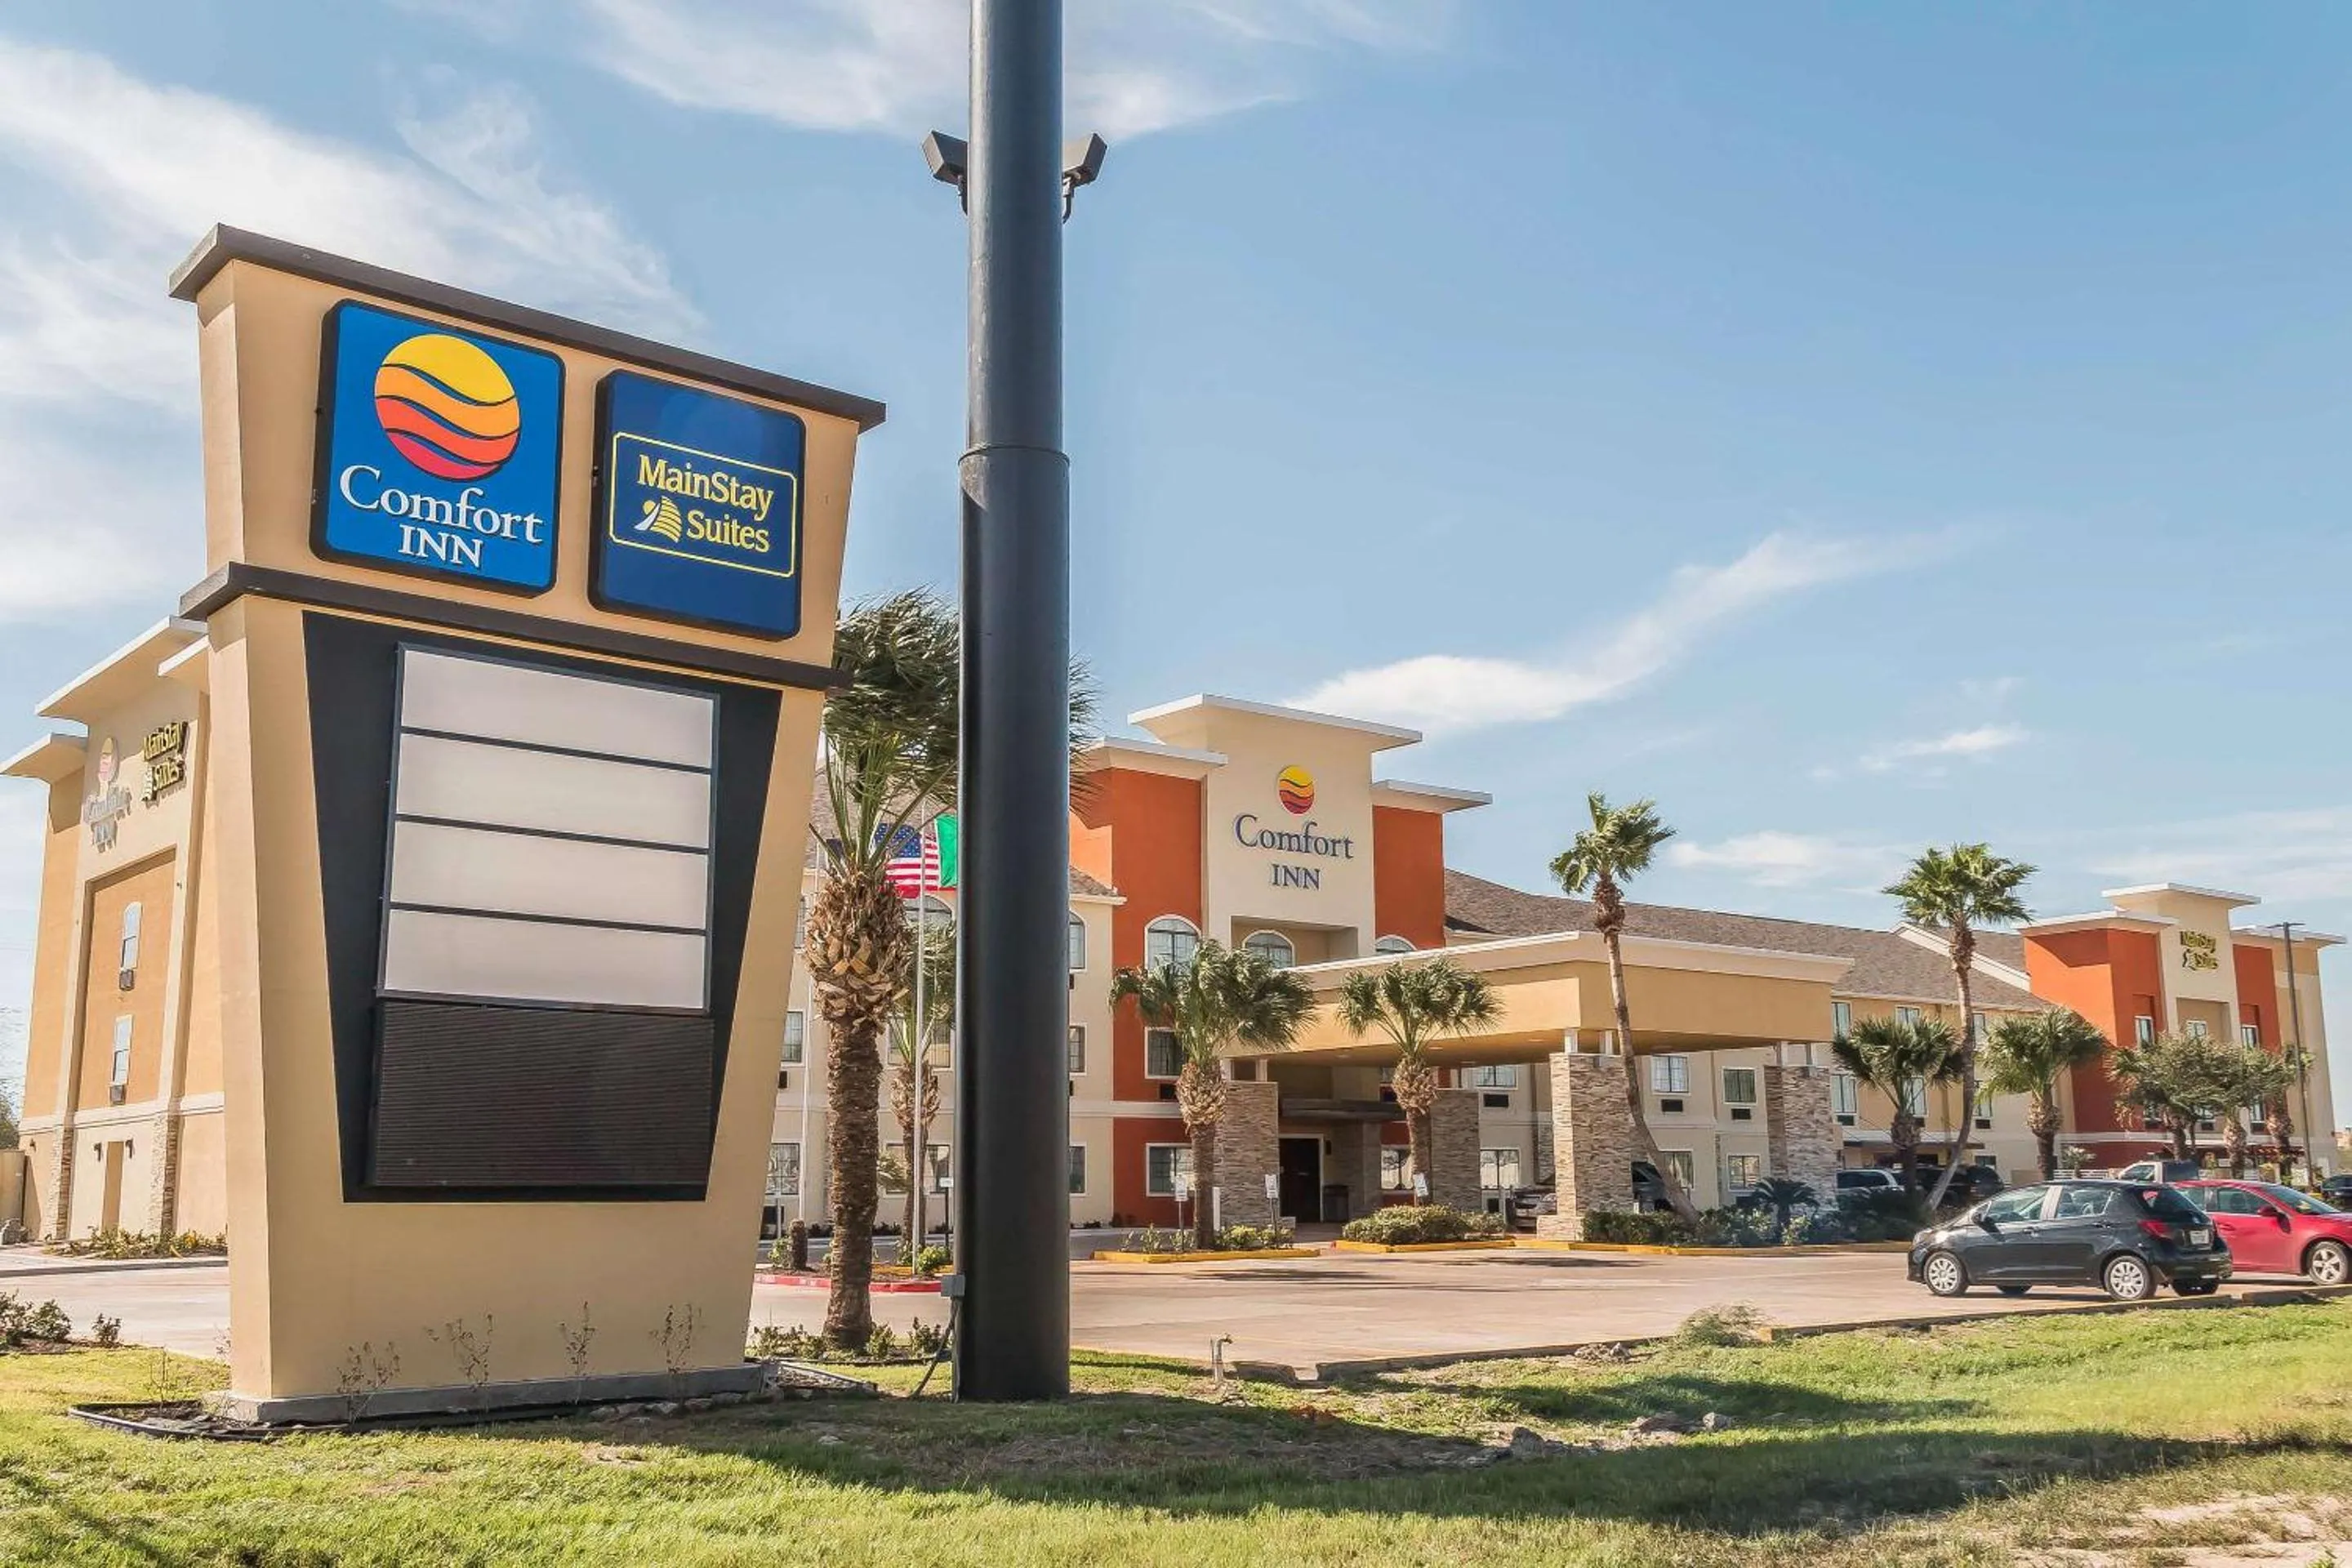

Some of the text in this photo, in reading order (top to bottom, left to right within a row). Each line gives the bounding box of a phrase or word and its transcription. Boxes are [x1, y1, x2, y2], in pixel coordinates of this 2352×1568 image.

[340, 465, 543, 543] Comfort
[637, 454, 773, 521] MainStay
[398, 524, 483, 568] INN
[686, 509, 770, 553] Suites
[1235, 814, 1353, 859] Comfort
[1272, 863, 1321, 890] INN
